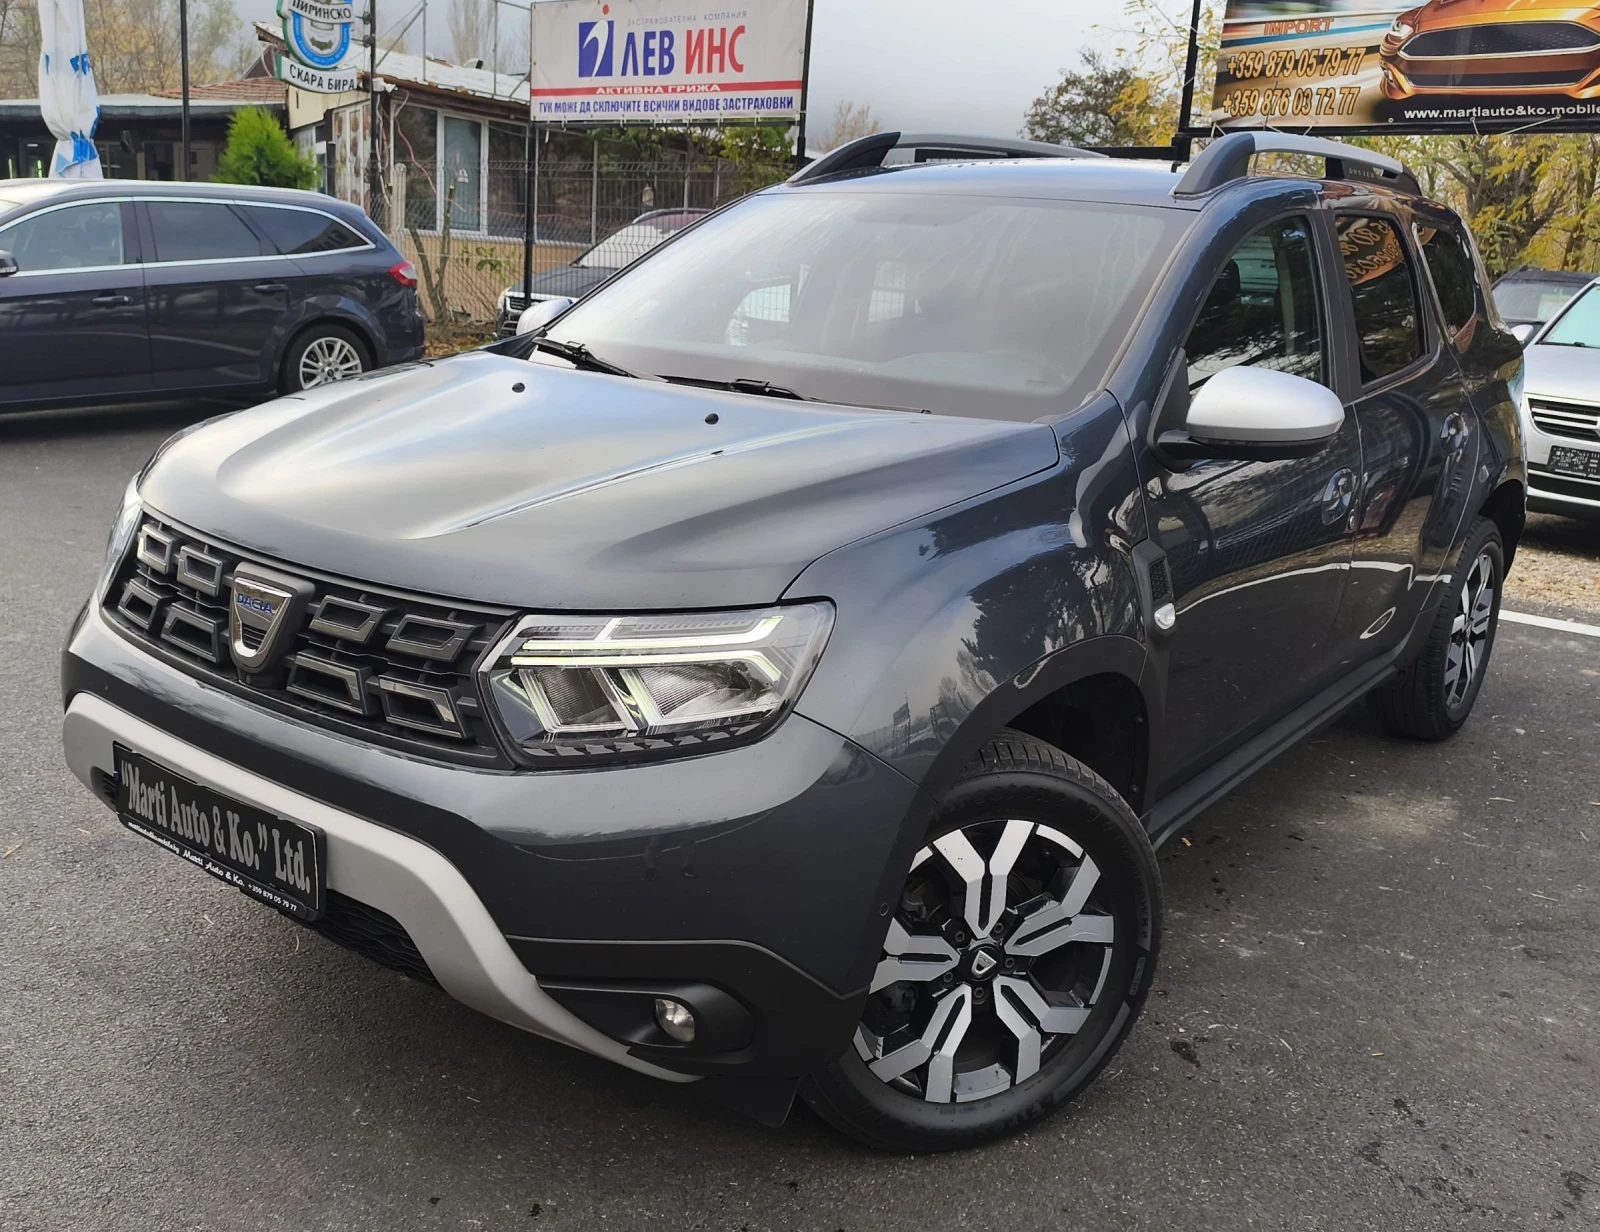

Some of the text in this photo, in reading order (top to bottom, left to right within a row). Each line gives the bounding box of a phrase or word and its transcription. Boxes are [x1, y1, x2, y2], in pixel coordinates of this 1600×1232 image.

[292, 0, 352, 20] ПИРИНСКО
[703, 10, 748, 22] КОМПАНИЯ
[1263, 18, 1335, 36] IMPORT
[620, 24, 746, 77] ЛЕВ ИНС
[1227, 46, 1367, 79] +359 879 05 79 77
[289, 63, 356, 91] СКАРА БИРА
[595, 84, 721, 95] АКТИВНА ГРИЖА
[539, 96, 794, 114] ТУК МОЖЕ ДА СКЛЮЧИТЕ ВСИЧКИ ВИДОВЕ ЗАСТРАХОВКИ
[1222, 86, 1362, 117] +359 876 03 72 77
[236, 593, 273, 615] DACIA
[170, 785, 210, 847] Auto
[212, 805, 227, 856] &
[272, 829, 311, 894] Ltd.
[182, 849, 204, 867] Marti
[204, 861, 224, 877] Auto
[225, 871, 232, 881] &
[247, 883, 262, 895] +359
[290, 903, 297, 912] 77
